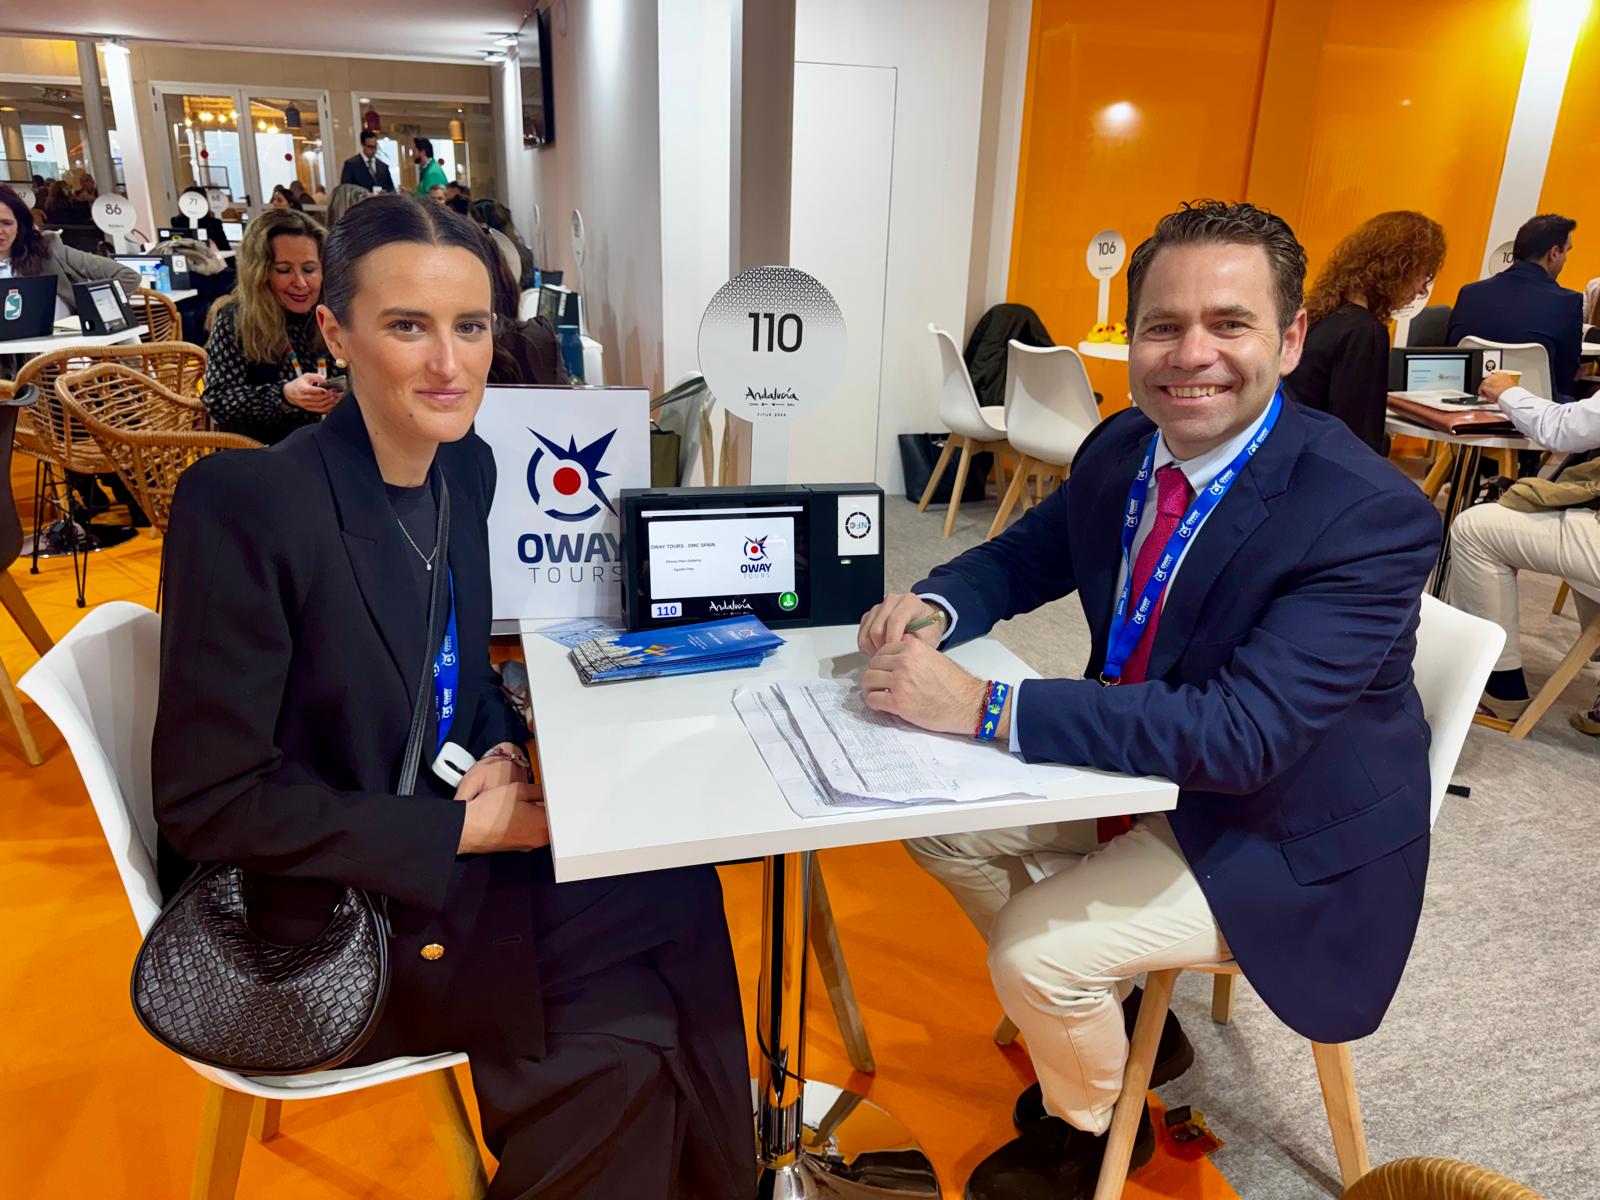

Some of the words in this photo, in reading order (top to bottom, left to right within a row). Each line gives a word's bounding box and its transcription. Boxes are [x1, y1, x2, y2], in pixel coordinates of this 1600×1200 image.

[189, 197, 198, 206] 71
[105, 203, 122, 215] 86
[1098, 240, 1116, 255] 106
[1502, 252, 1514, 263] 10
[748, 312, 803, 352] 110
[744, 386, 800, 401] Andalucía
[518, 532, 622, 564] OWAY
[528, 566, 624, 584] TOURS
[740, 562, 772, 574] OWAY
[656, 605, 677, 617] 110
[709, 598, 753, 612] Andalucía
